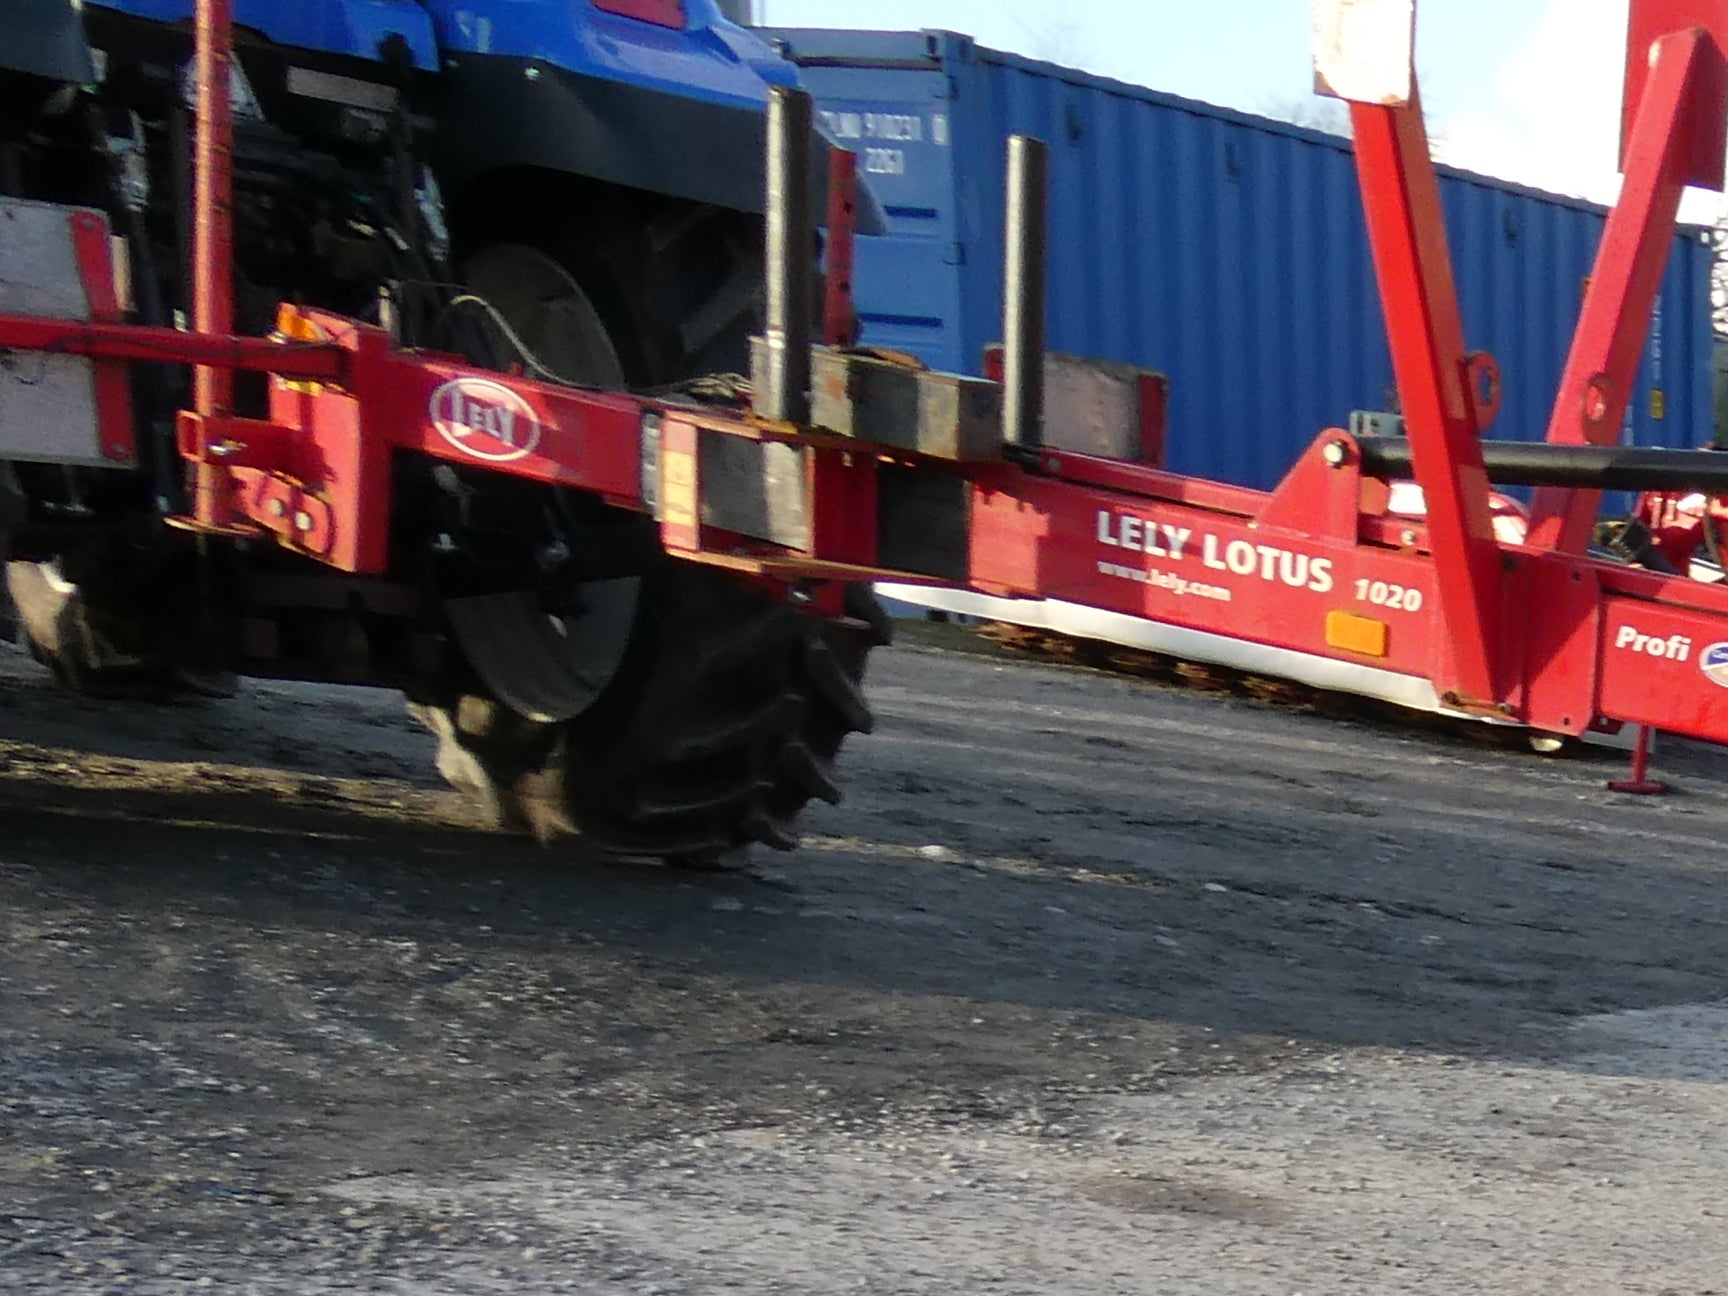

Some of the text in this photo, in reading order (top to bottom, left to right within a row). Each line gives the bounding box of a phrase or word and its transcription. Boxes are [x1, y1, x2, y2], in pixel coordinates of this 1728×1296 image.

[1097, 510, 1333, 593] LELY LOTUS
[1097, 561, 1232, 603] www.lely.com
[1354, 578, 1423, 613] 1020
[1614, 625, 1692, 662] Profi
